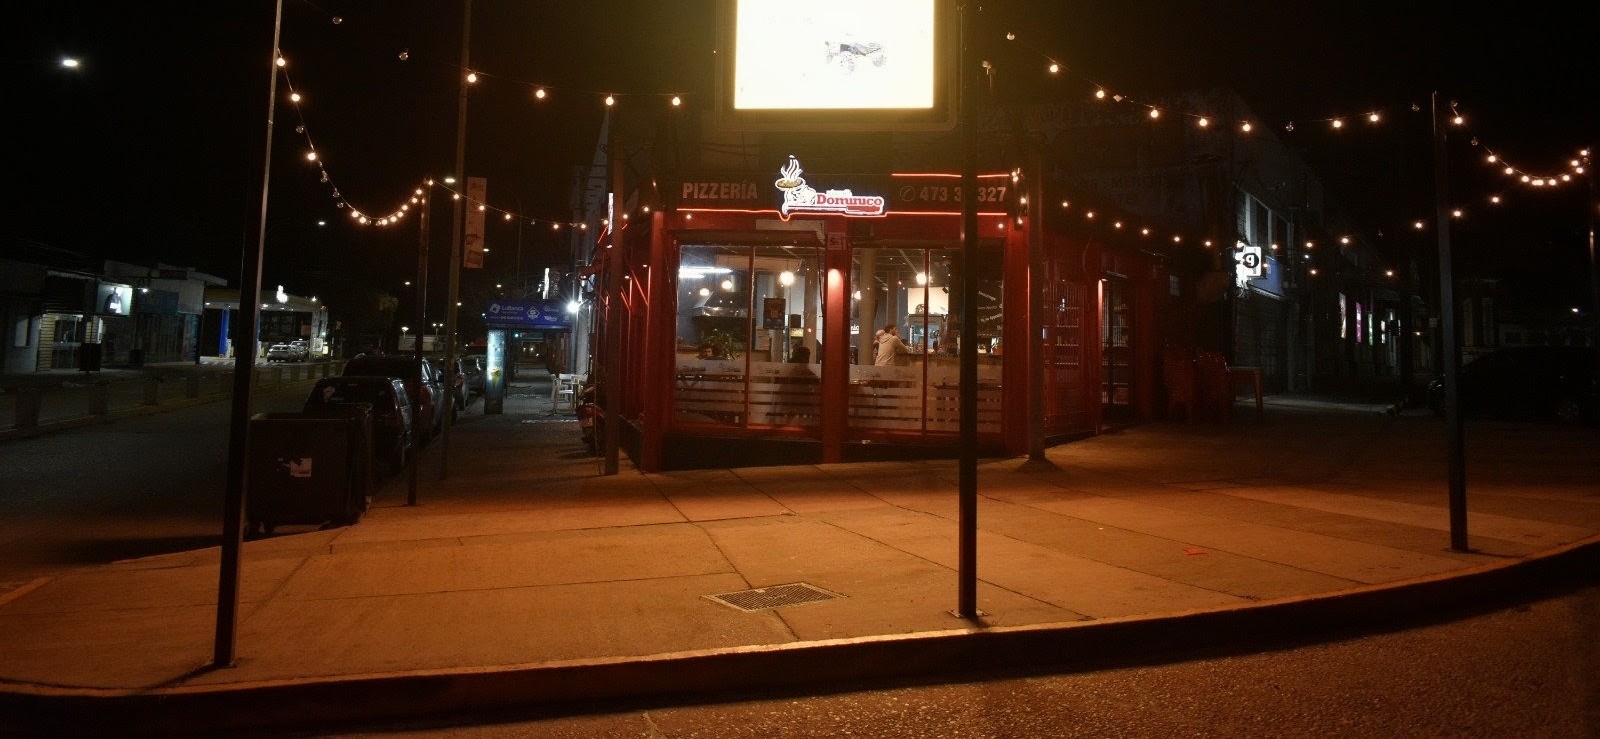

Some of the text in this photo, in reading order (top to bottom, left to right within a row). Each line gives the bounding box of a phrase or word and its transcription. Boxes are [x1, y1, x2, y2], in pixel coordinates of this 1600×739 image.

[682, 179, 758, 199] PIZZERÍA
[919, 186, 948, 201] 473
[816, 194, 883, 206] Dominico
